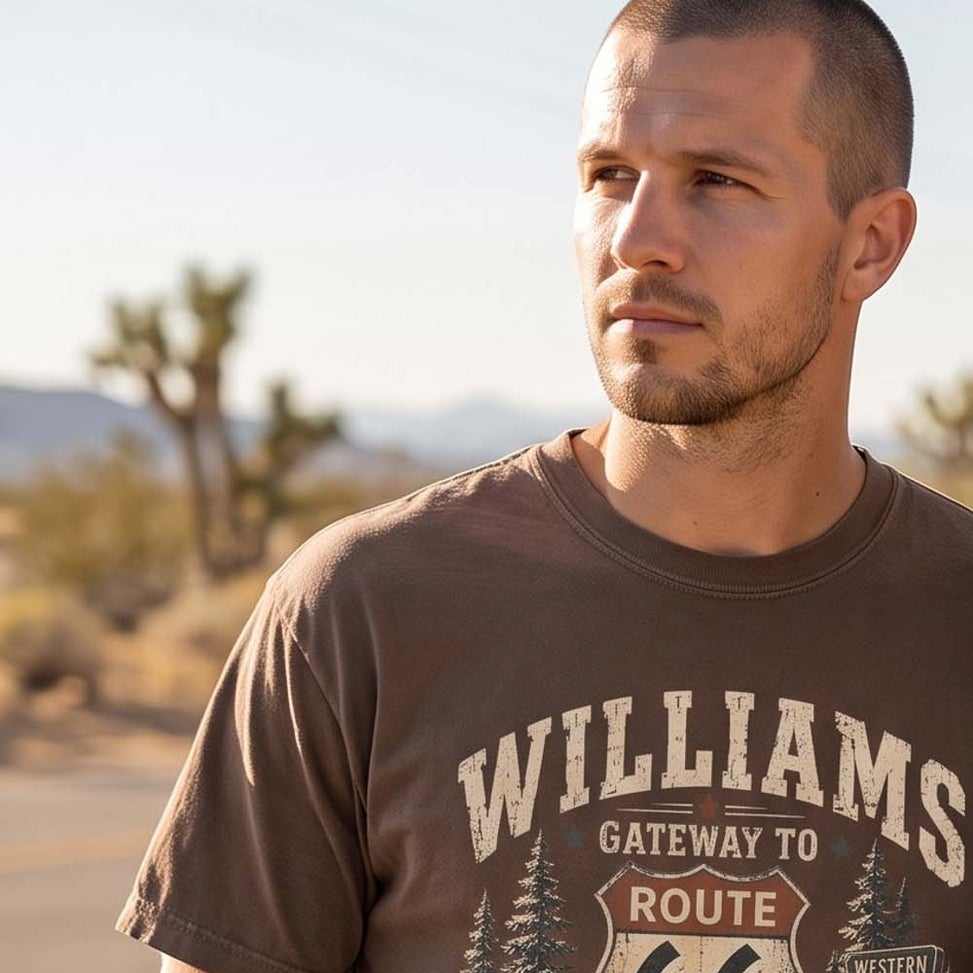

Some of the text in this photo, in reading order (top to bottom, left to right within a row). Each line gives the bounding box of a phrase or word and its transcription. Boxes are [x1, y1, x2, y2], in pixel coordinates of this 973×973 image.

[458, 690, 965, 888] WILLIAMS
[600, 819, 818, 862] GATEWAY TO
[630, 886, 777, 927] ROUTE
